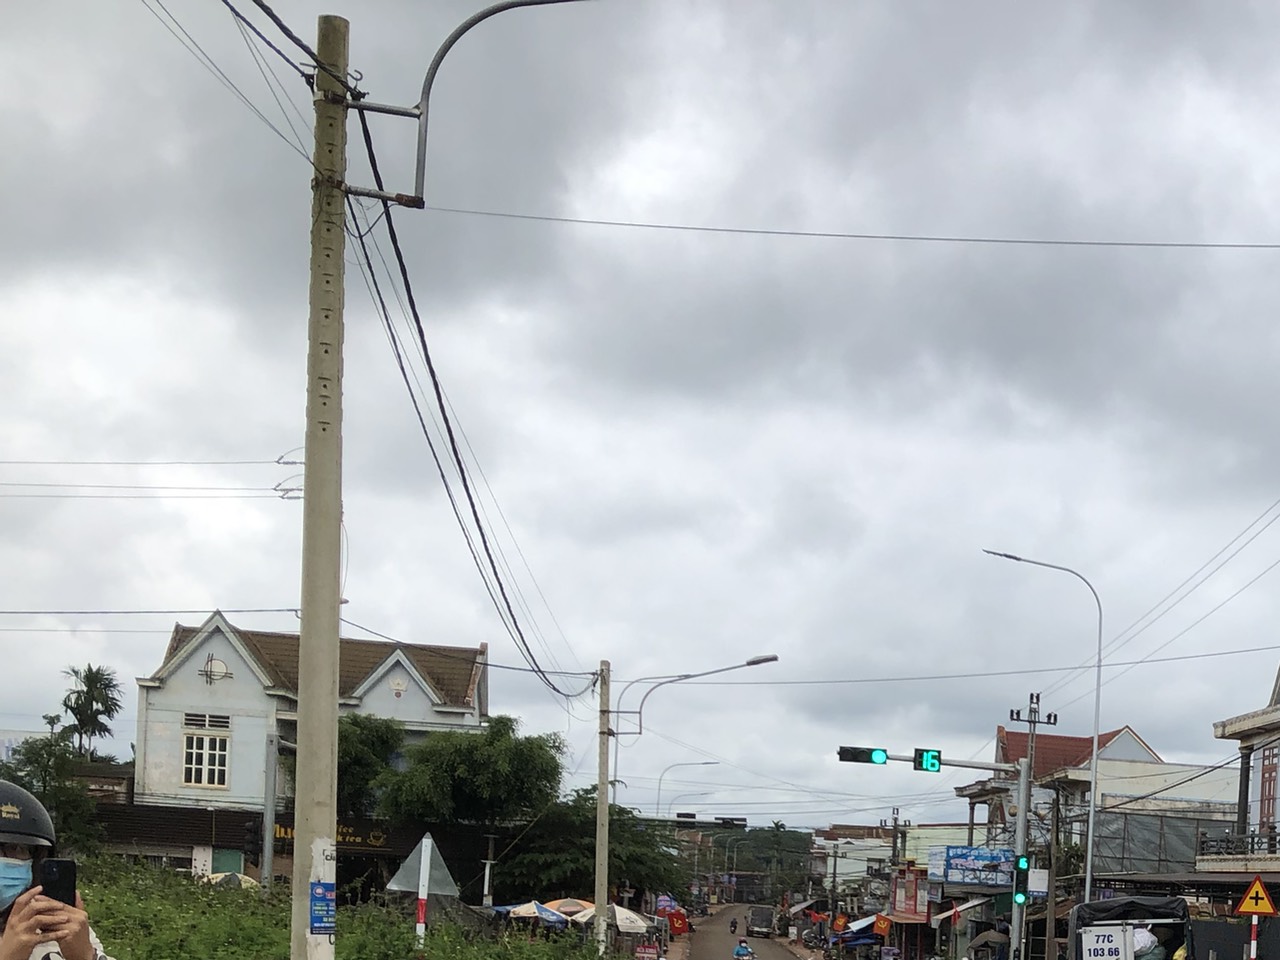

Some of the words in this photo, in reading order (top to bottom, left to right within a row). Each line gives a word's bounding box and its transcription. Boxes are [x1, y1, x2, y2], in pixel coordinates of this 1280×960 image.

[922, 751, 940, 772] 16
[1095, 934, 1114, 944] 77C
[1088, 947, 1120, 957] 103.66
